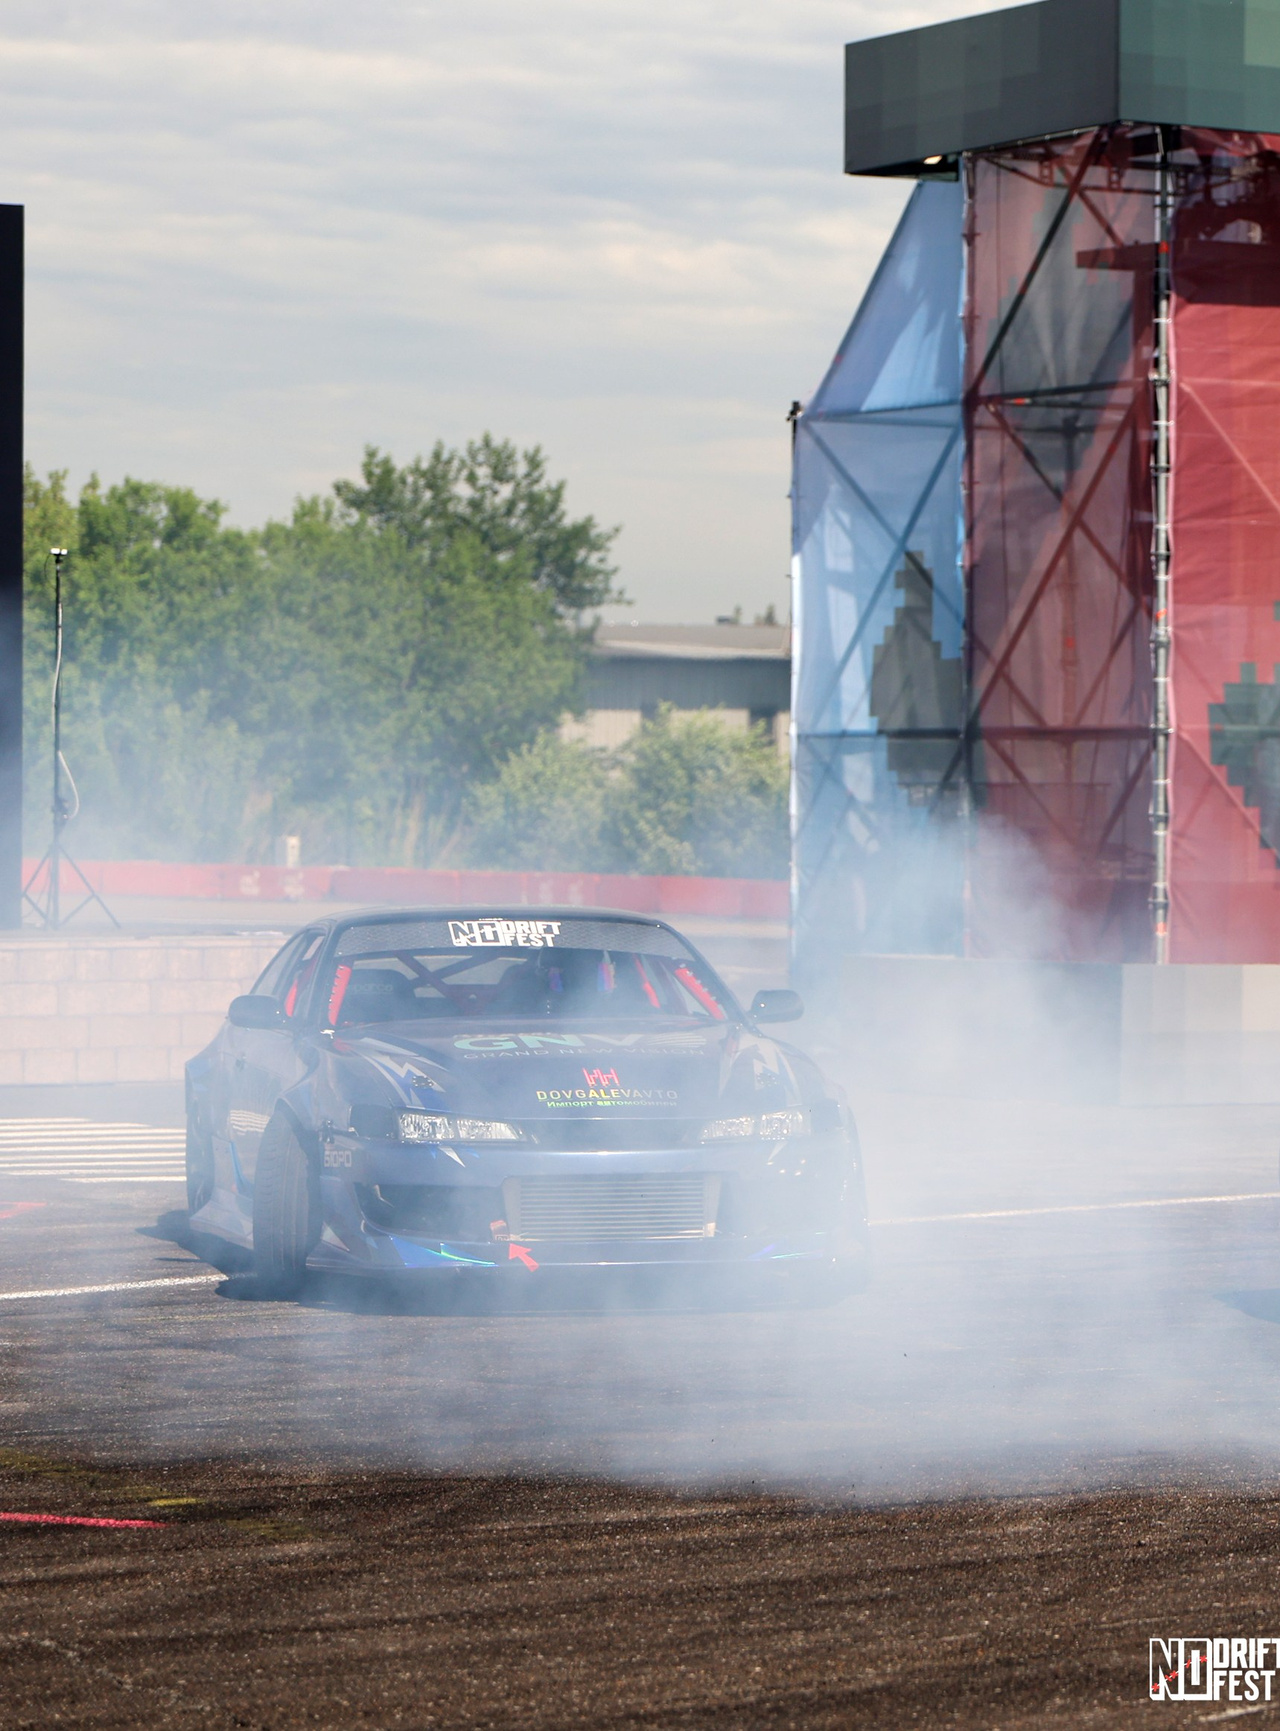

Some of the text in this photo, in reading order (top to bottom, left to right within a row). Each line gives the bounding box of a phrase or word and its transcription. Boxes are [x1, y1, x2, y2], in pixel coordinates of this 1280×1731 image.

[500, 920, 561, 935] DRIFT
[503, 933, 556, 947] FEST
[453, 1034, 645, 1051] GNV
[463, 1050, 549, 1060] GRAND
[624, 1048, 706, 1056] VISION
[536, 1088, 678, 1100] DOVGALEVAVTO
[547, 1100, 594, 1109] Импорт
